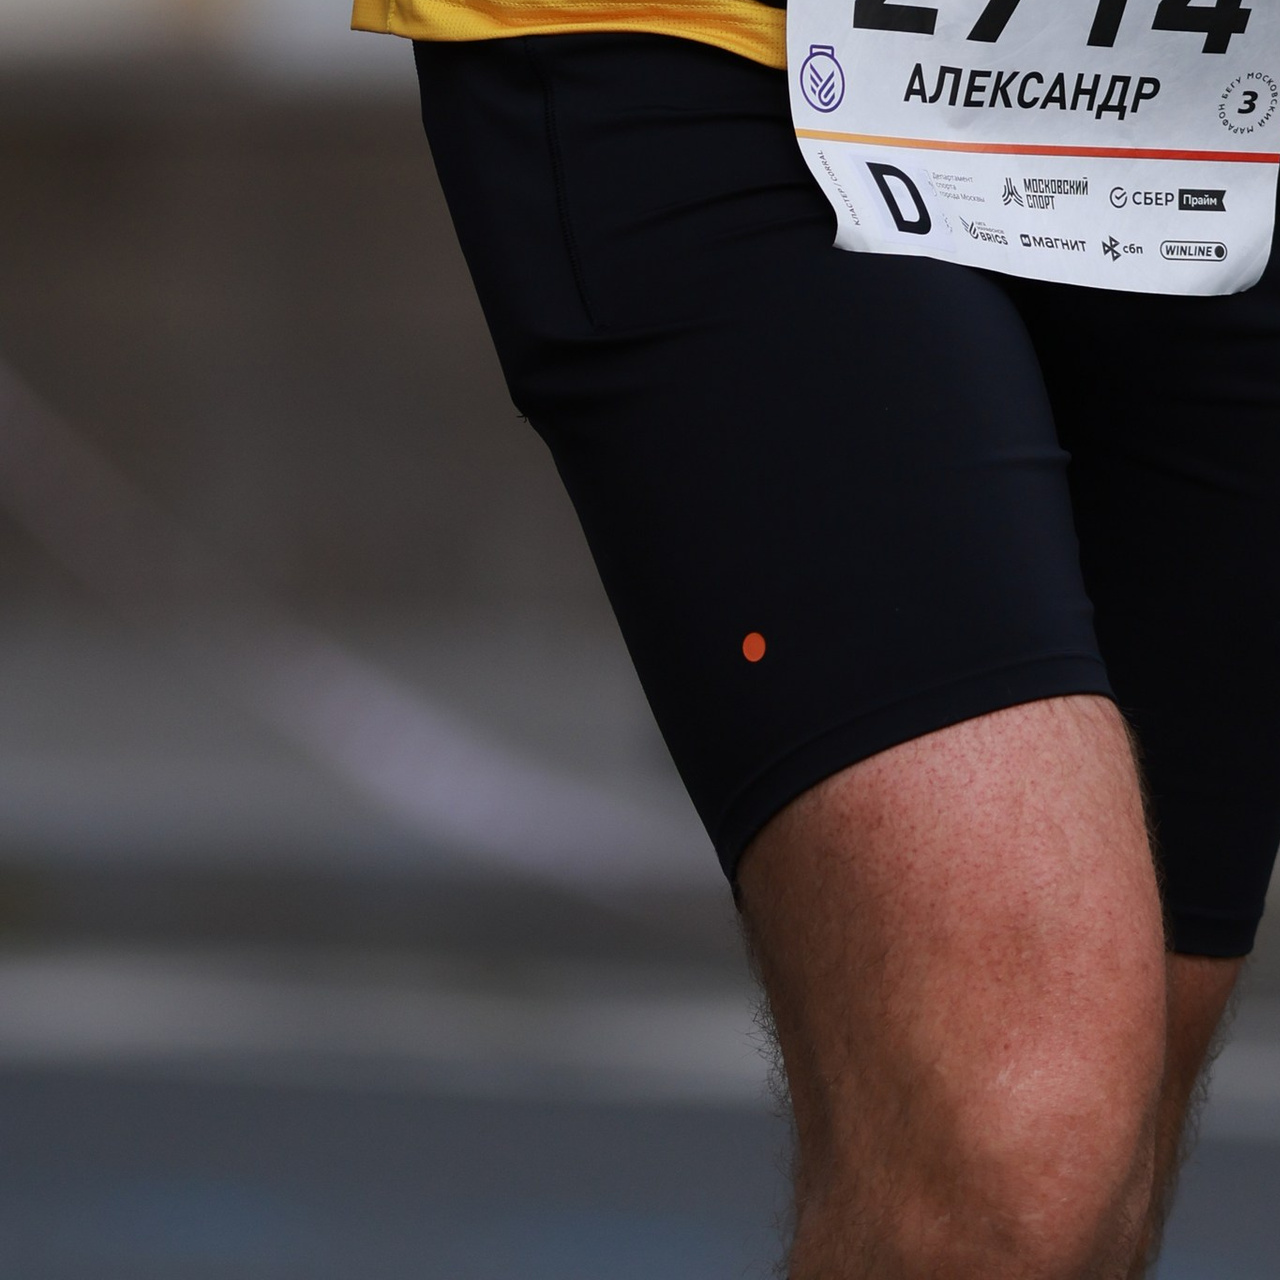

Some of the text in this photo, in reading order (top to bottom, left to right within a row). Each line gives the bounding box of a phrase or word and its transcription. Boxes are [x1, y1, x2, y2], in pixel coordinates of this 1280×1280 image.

[903, 63, 1161, 121] АЛЕКСАНДР
[1237, 90, 1258, 114] 3
[1218, 72, 1278, 134] БЕГУ МОСКОВСКИЙ МАРАФОН
[817, 150, 837, 181] CORRAL
[1023, 177, 1088, 195] МОСКОВСКИЙ
[837, 187, 861, 226] КЛАСТЕР
[865, 161, 932, 235] D
[1026, 195, 1055, 210] СПОРТ
[1132, 191, 1217, 207] СБЕР Прайм
[980, 232, 1008, 245] BRICS
[1122, 243, 1143, 254] сбп
[1165, 245, 1212, 257] WINLINE
